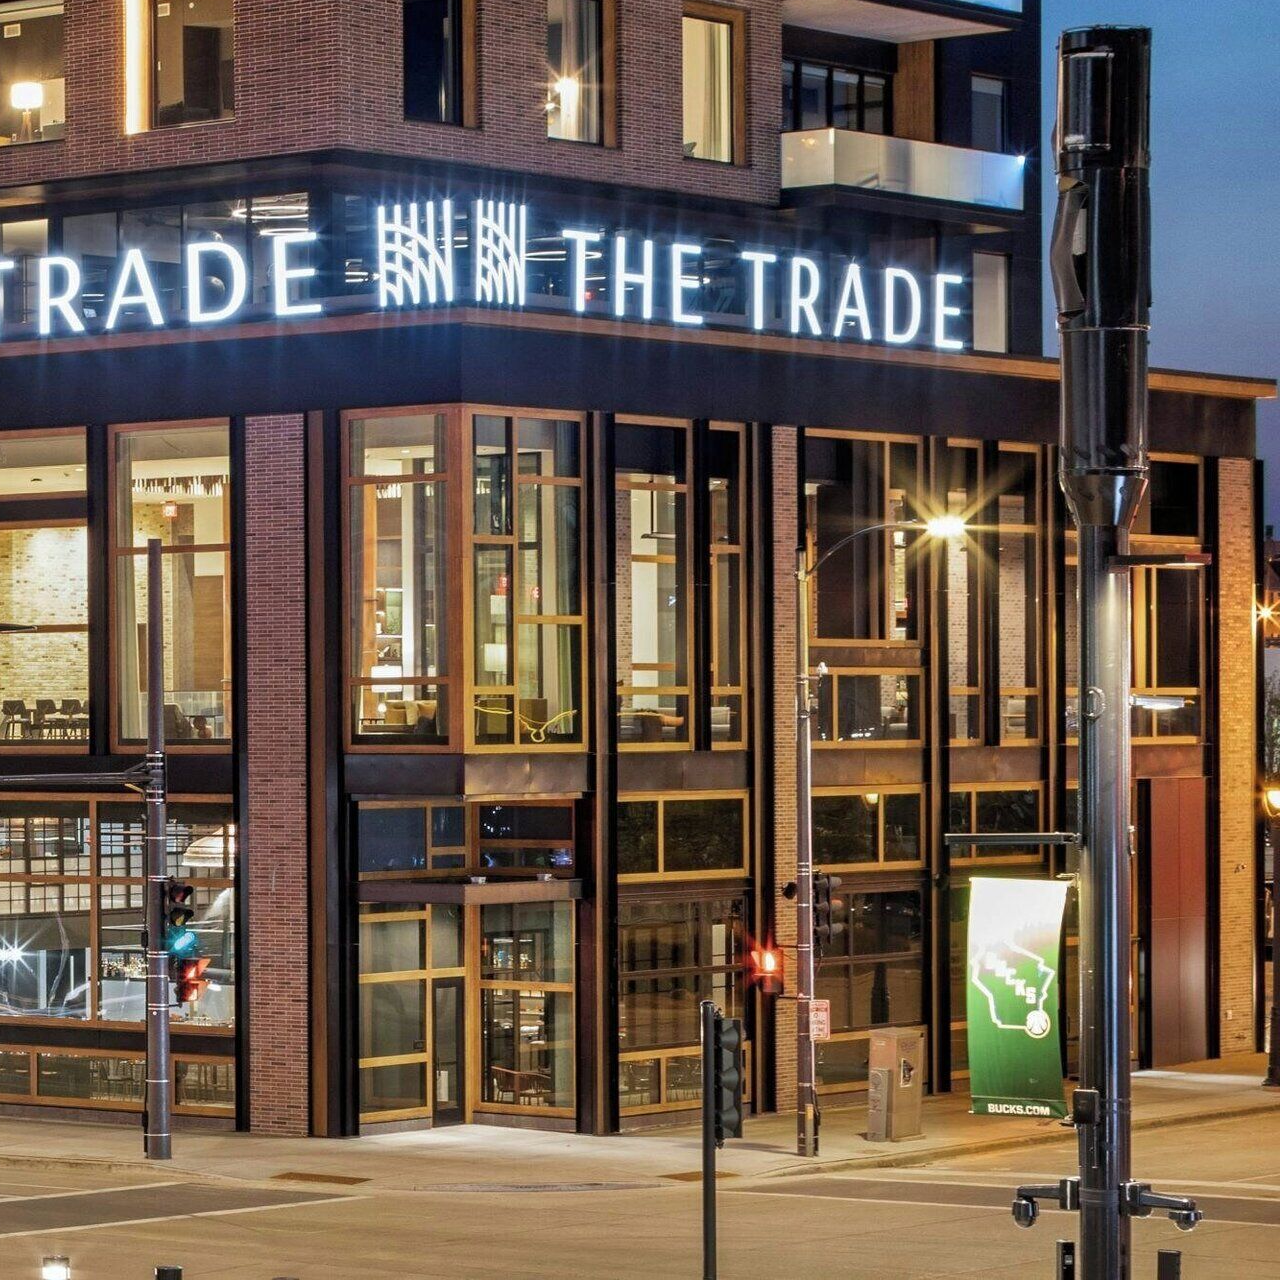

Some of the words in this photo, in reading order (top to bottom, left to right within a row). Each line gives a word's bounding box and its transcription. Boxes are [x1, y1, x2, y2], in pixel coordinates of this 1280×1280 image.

[561, 228, 705, 325] THE
[741, 249, 965, 350] TRADE
[987, 1103, 1051, 1116] BUCKS.COM
